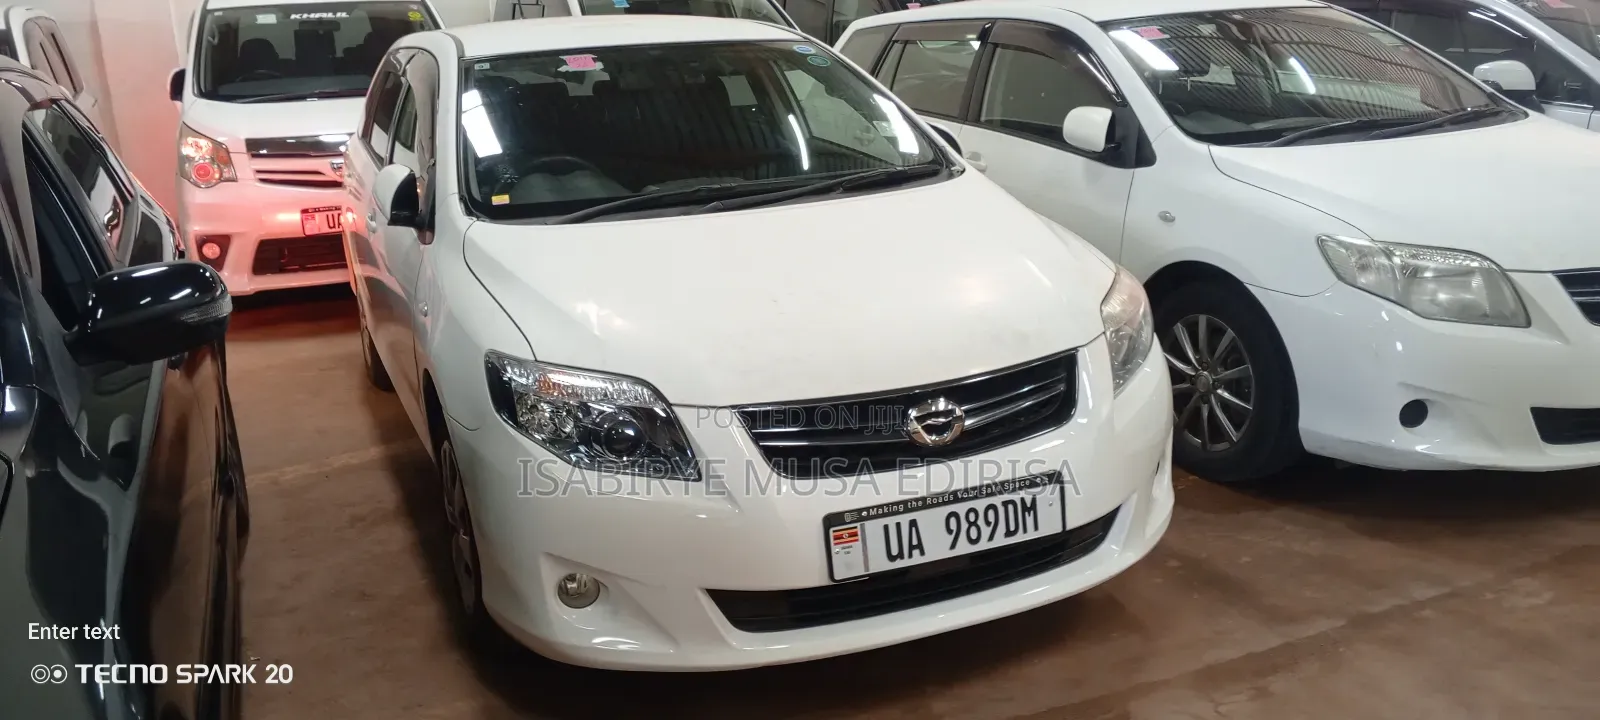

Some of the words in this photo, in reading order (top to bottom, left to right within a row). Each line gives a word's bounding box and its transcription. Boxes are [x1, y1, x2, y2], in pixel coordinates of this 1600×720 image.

[290, 11, 350, 20] KHALIL
[869, 504, 904, 517] Making
[907, 500, 923, 509] the
[926, 493, 954, 505] Roads
[957, 488, 978, 499] Your
[981, 483, 1001, 495] Safe
[1003, 479, 1030, 492] Space
[883, 518, 926, 563] UA
[944, 494, 1040, 551] 989DM
